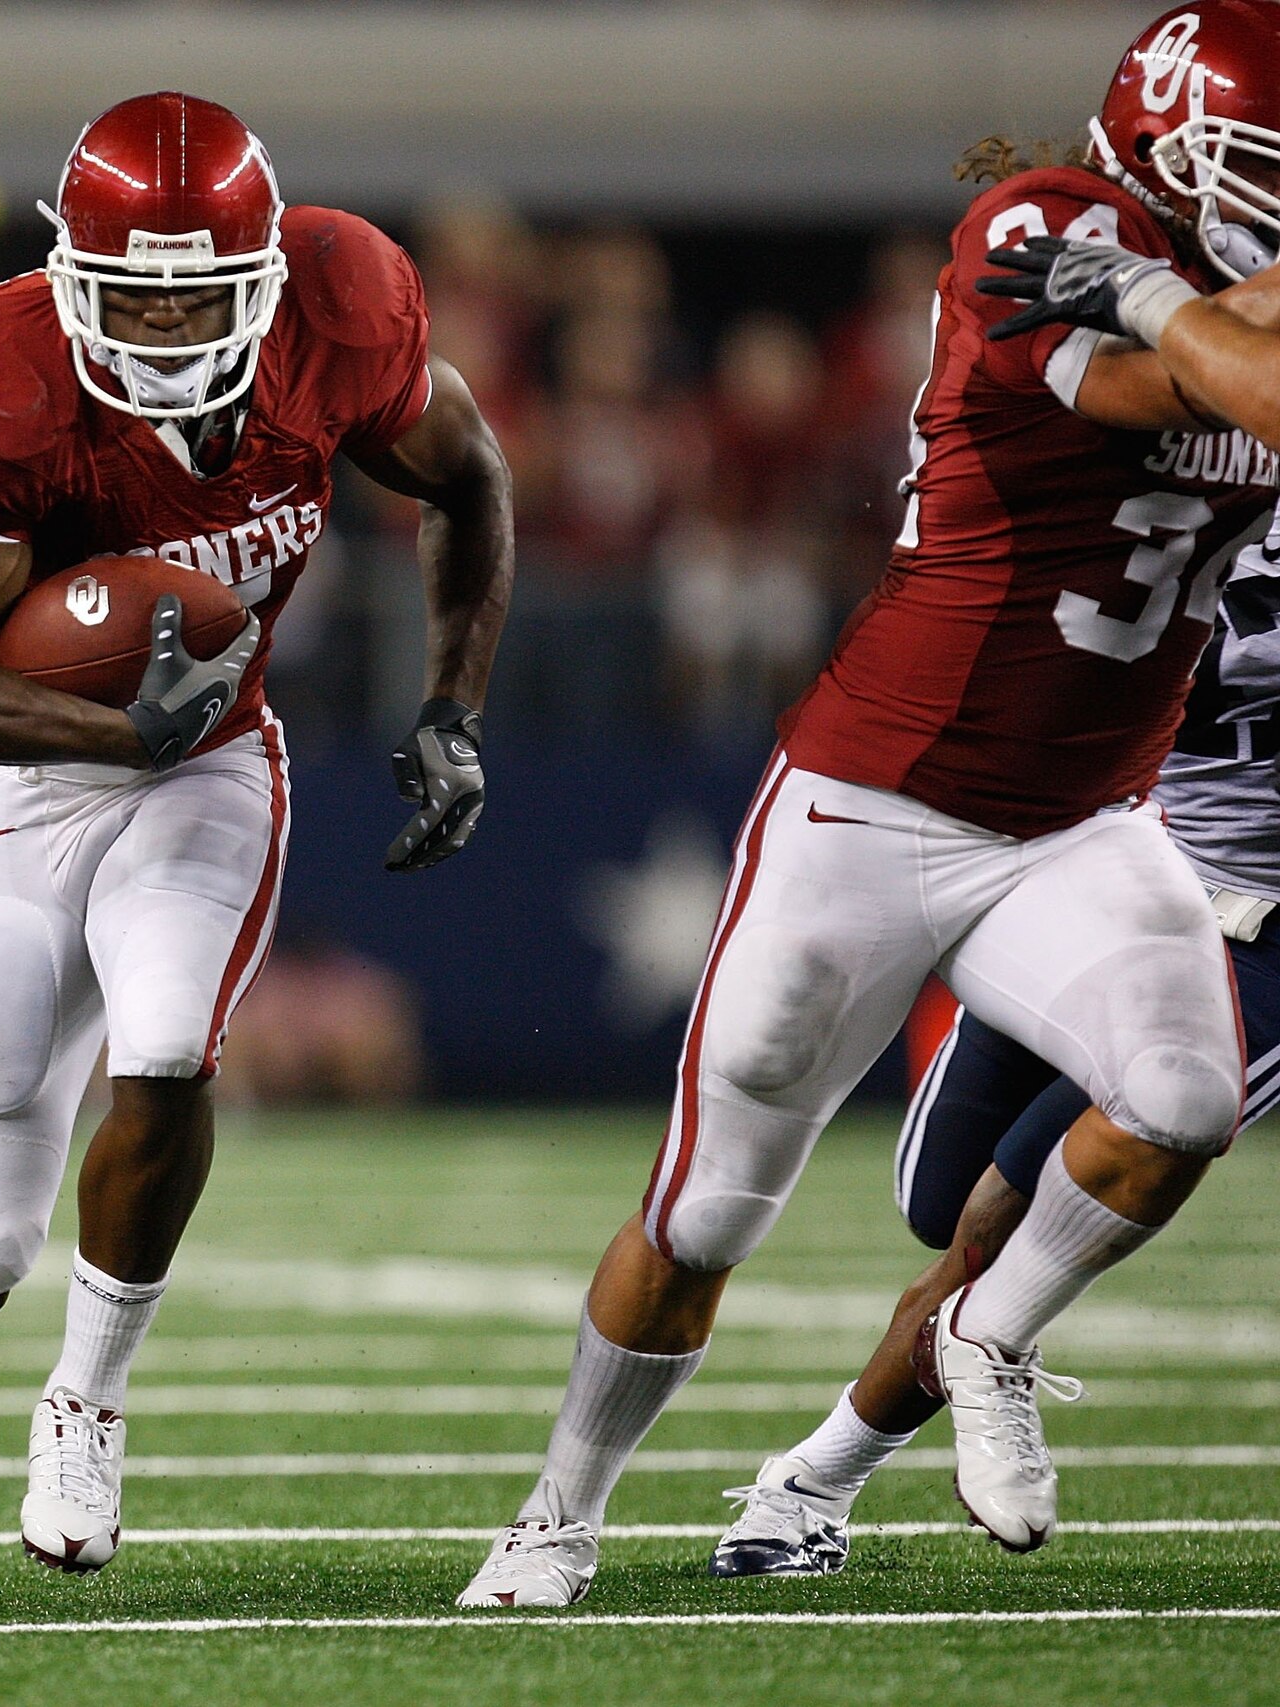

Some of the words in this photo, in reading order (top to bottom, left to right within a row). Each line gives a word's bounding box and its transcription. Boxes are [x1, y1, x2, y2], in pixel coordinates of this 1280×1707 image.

[1141, 12, 1200, 114] OU
[147, 240, 194, 250] OKLAHOMA
[1144, 428, 1280, 487] SOONE
[65, 574, 110, 626] OU
